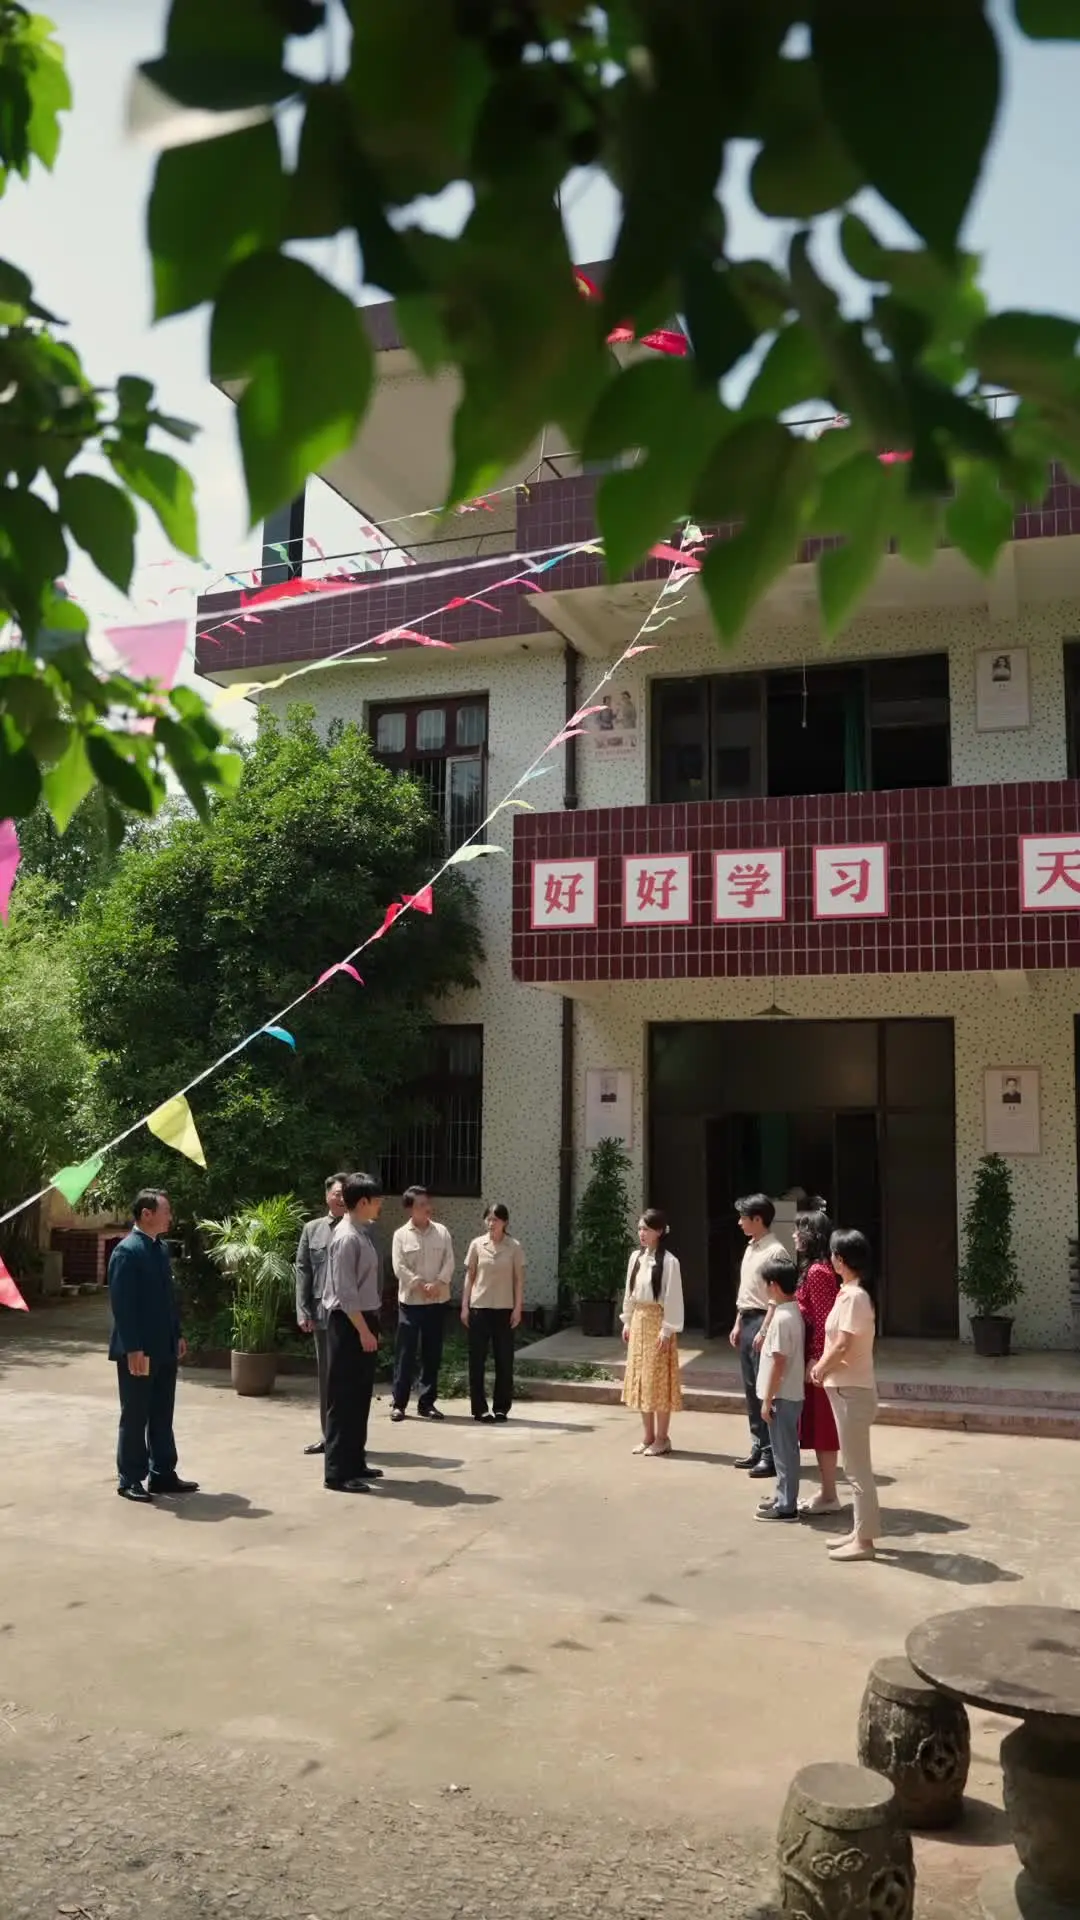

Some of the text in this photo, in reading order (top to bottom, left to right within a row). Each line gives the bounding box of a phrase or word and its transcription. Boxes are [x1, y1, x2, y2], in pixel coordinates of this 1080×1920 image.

[544, 849, 1080, 914] 好好学习 天
